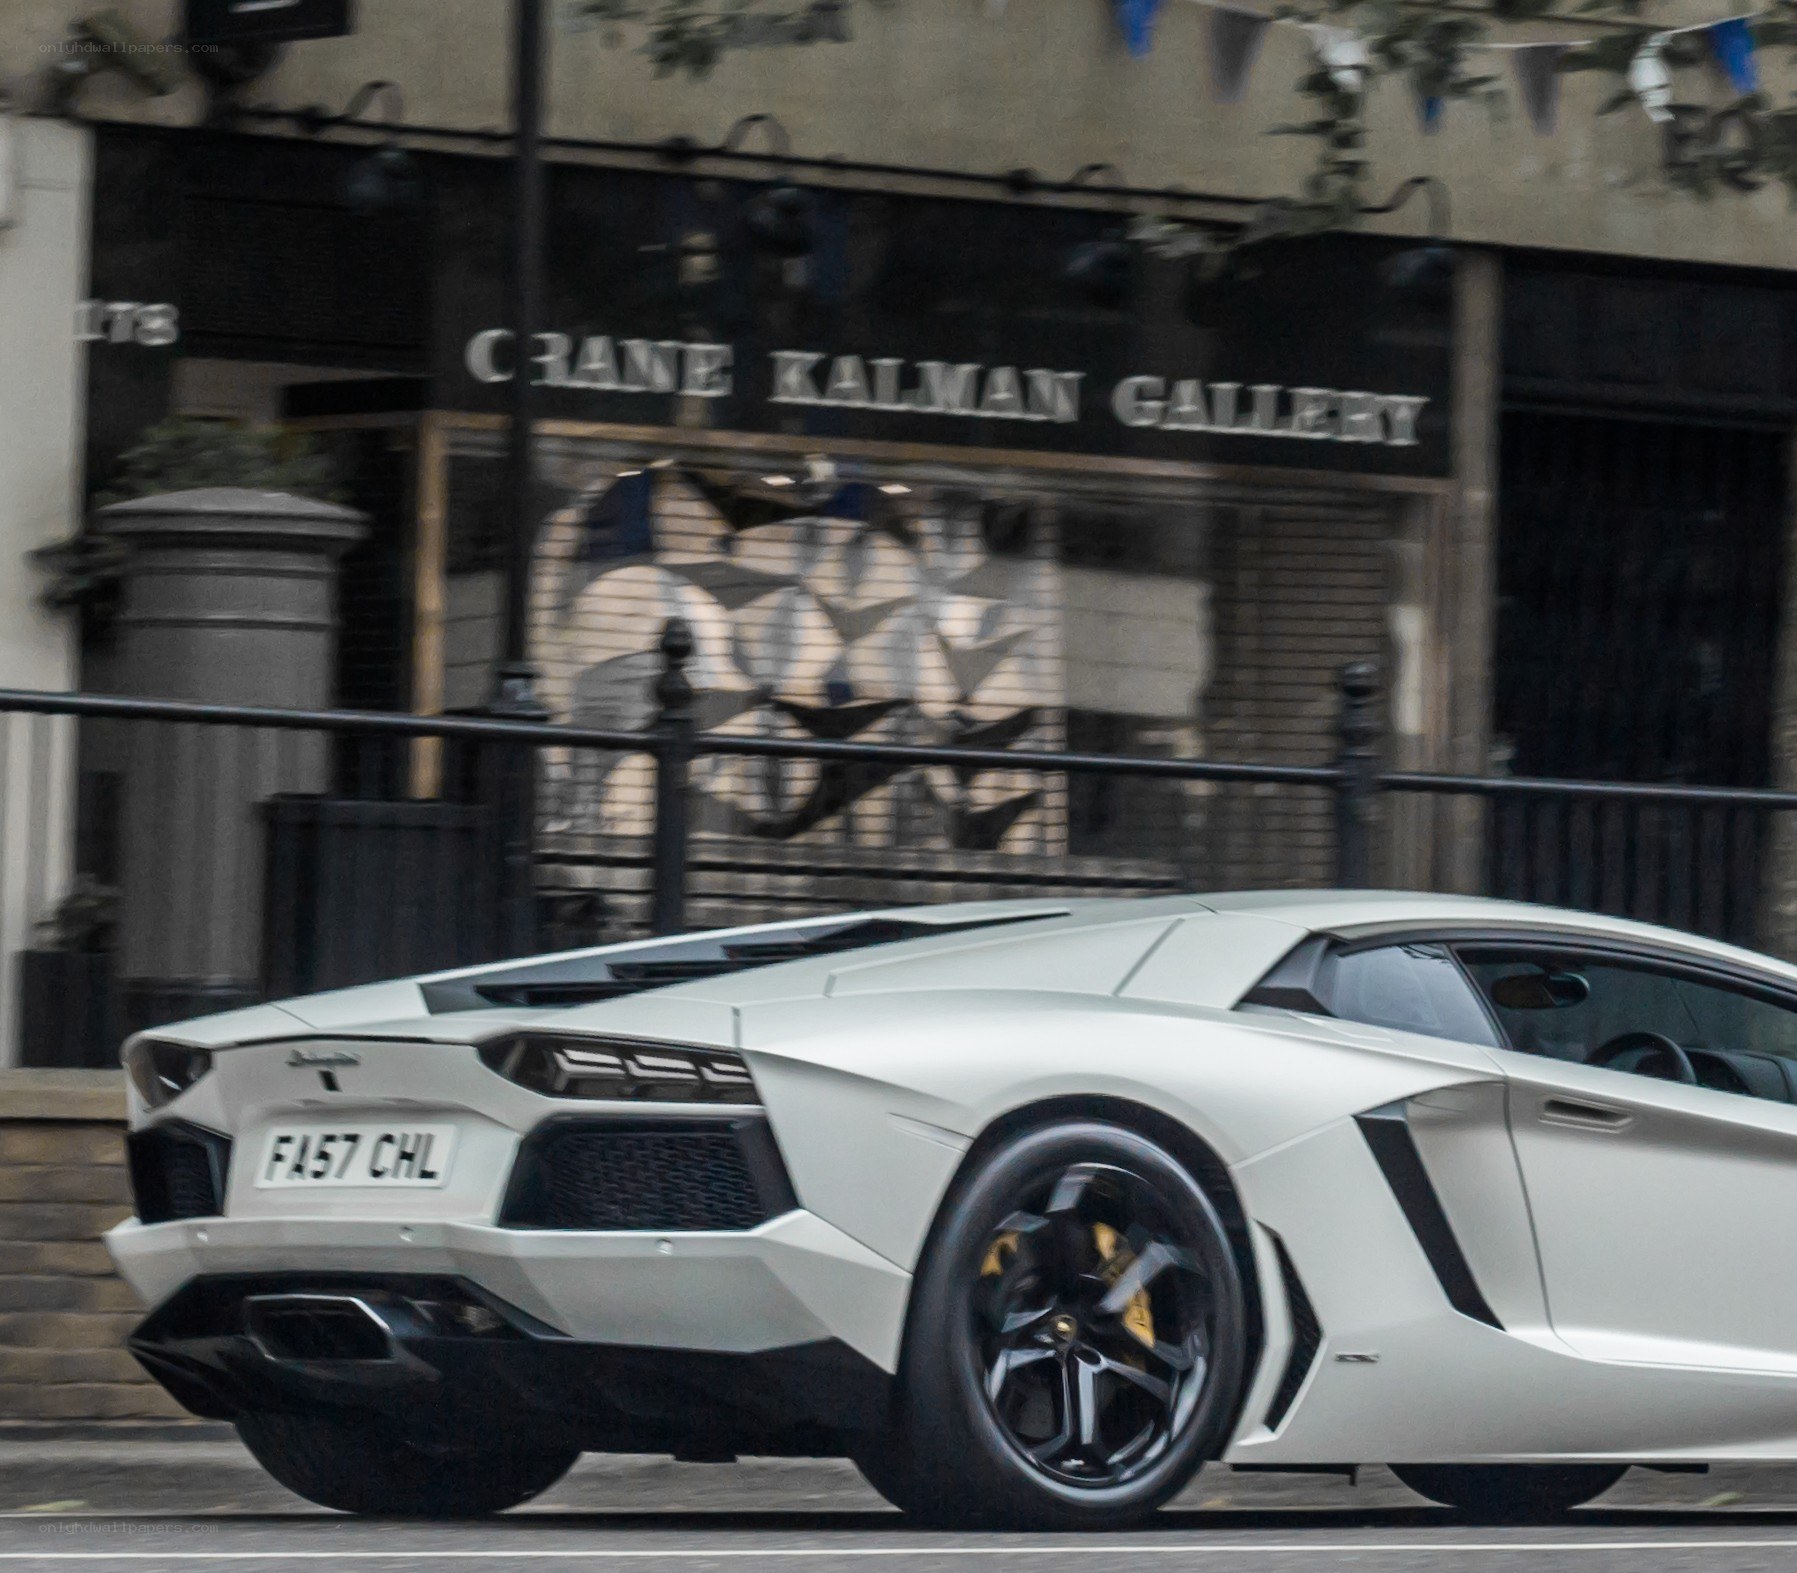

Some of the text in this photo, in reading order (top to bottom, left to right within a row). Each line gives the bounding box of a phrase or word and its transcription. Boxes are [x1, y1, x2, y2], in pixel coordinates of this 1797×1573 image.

[74, 298, 179, 346] 178
[465, 328, 1430, 446] CRANE KALMAN GALLERY
[264, 1133, 438, 1181] FA57 CHL
